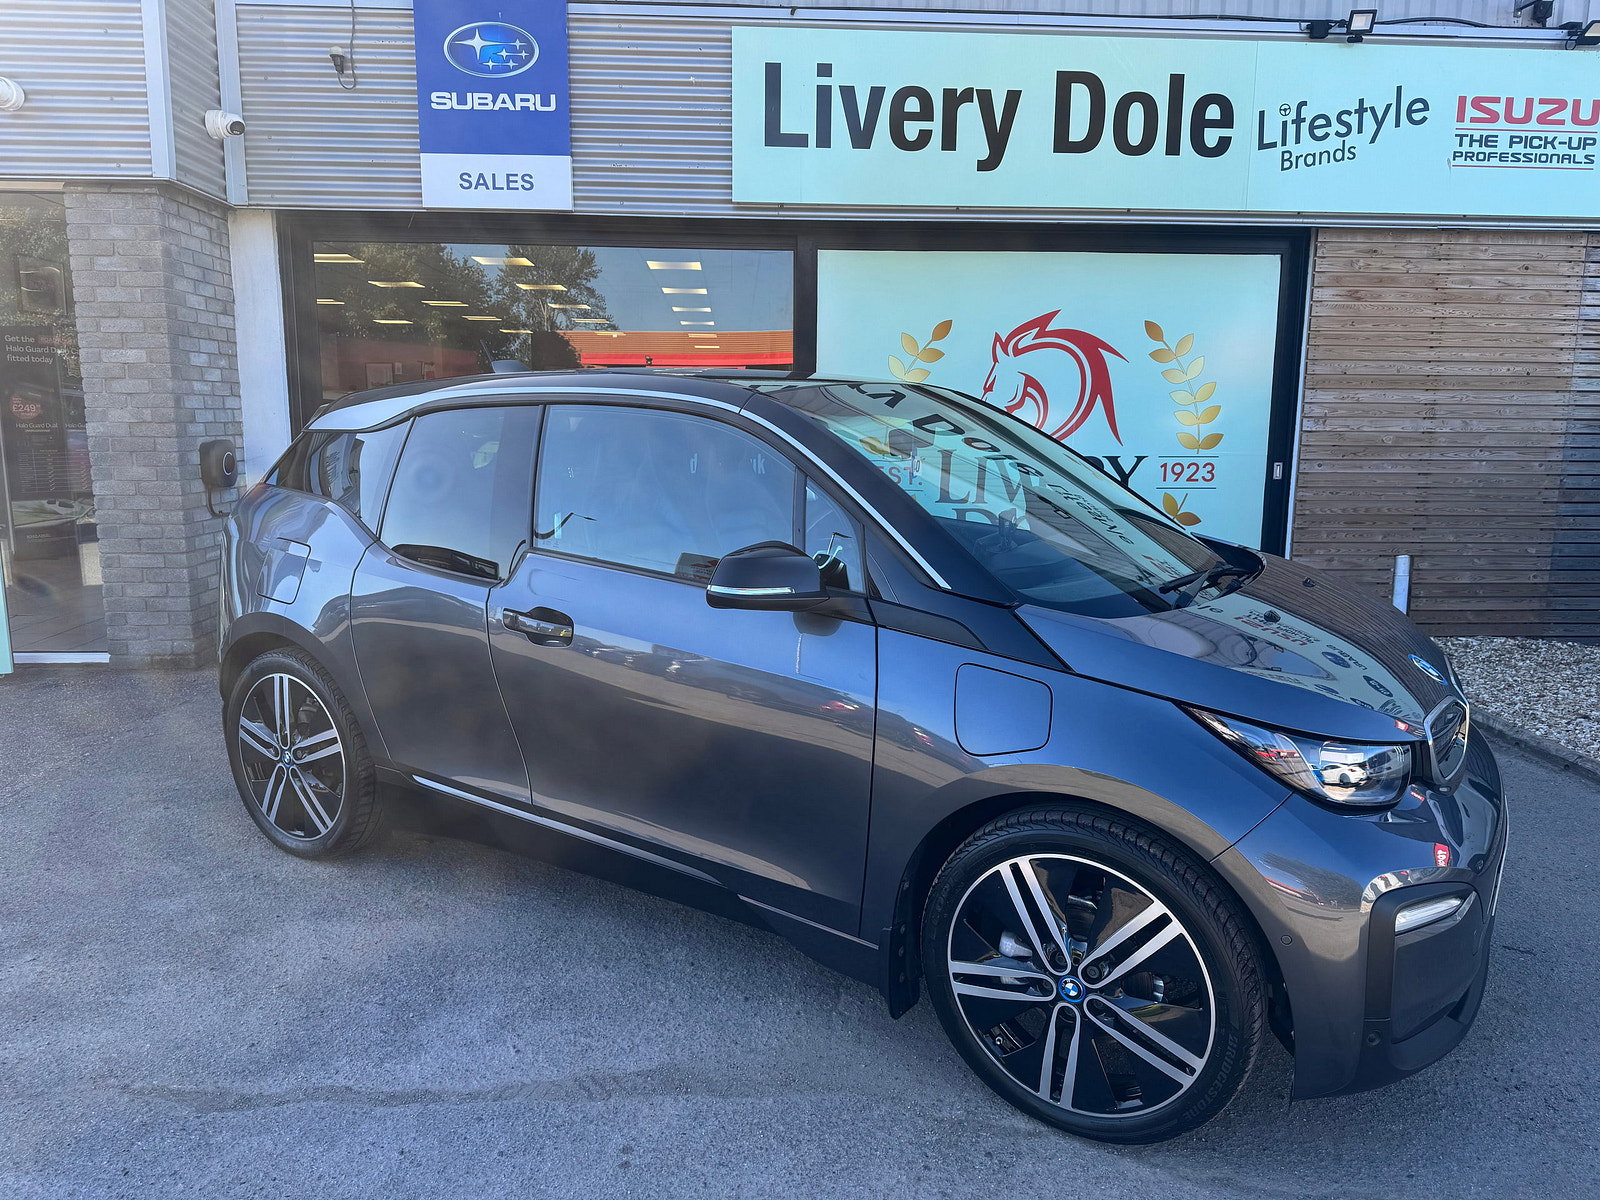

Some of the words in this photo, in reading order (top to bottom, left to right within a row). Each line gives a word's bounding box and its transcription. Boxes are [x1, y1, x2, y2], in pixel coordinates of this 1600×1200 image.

[429, 91, 557, 112] SUBARU
[1455, 95, 1600, 127] ISUZU
[763, 61, 1023, 172] Livery
[1052, 69, 1236, 159] Dole
[1256, 84, 1431, 151] Lifestyle
[1454, 133, 1499, 149] THE
[1508, 134, 1598, 151] PICK-UP
[1279, 139, 1358, 172] Brands
[1451, 150, 1597, 166] PROFESSIONALS
[458, 171, 535, 192] SALES
[4, 334, 20, 343] Get
[21, 335, 35, 343] the
[5, 344, 24, 353] Halo
[25, 345, 50, 354] Guard
[6, 353, 30, 363] fitted
[31, 355, 54, 366] today
[1159, 462, 1216, 483] 1923
